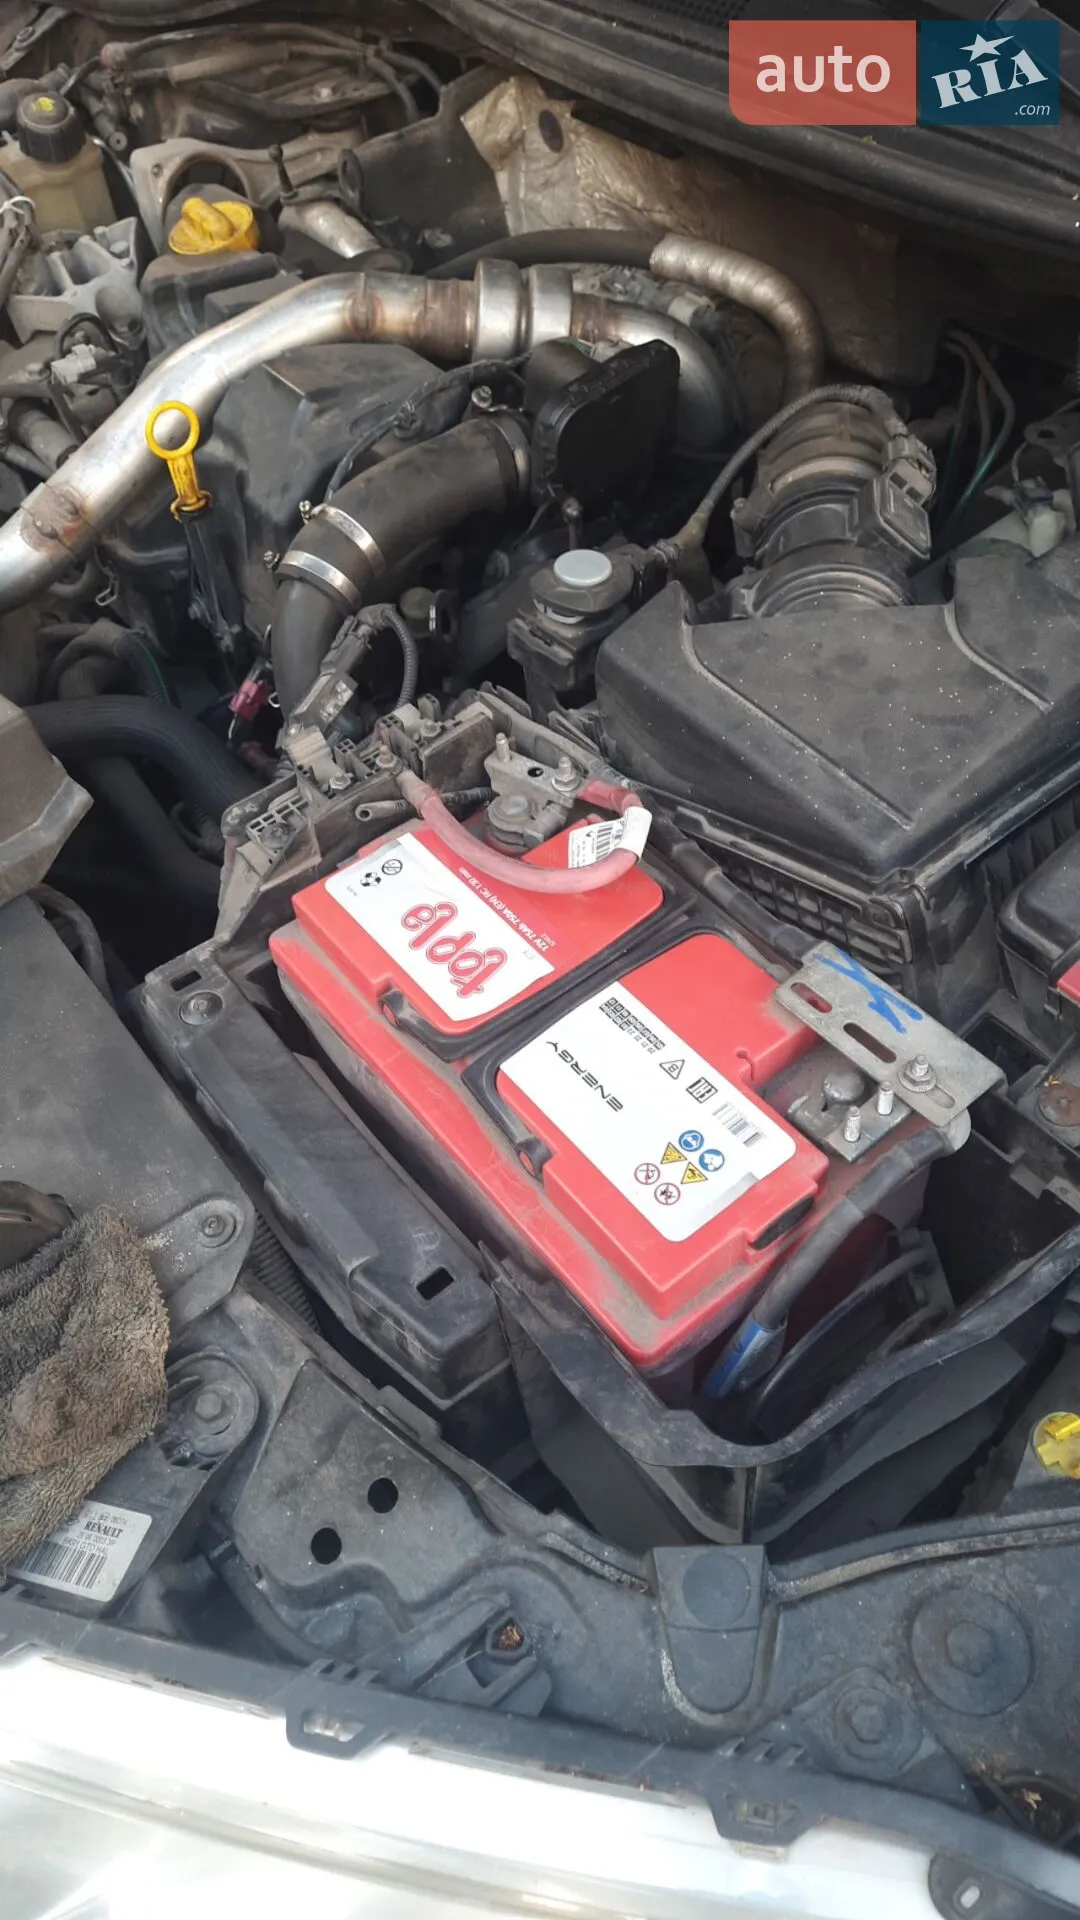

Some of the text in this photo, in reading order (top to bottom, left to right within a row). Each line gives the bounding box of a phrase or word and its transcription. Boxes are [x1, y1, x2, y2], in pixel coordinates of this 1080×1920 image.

[502, 908, 521, 923] 750A
[518, 922, 536, 938] 75Ah
[534, 937, 548, 950] 12V
[545, 1040, 624, 1112] ENERGY
[84, 1521, 124, 1538] RENAULT
